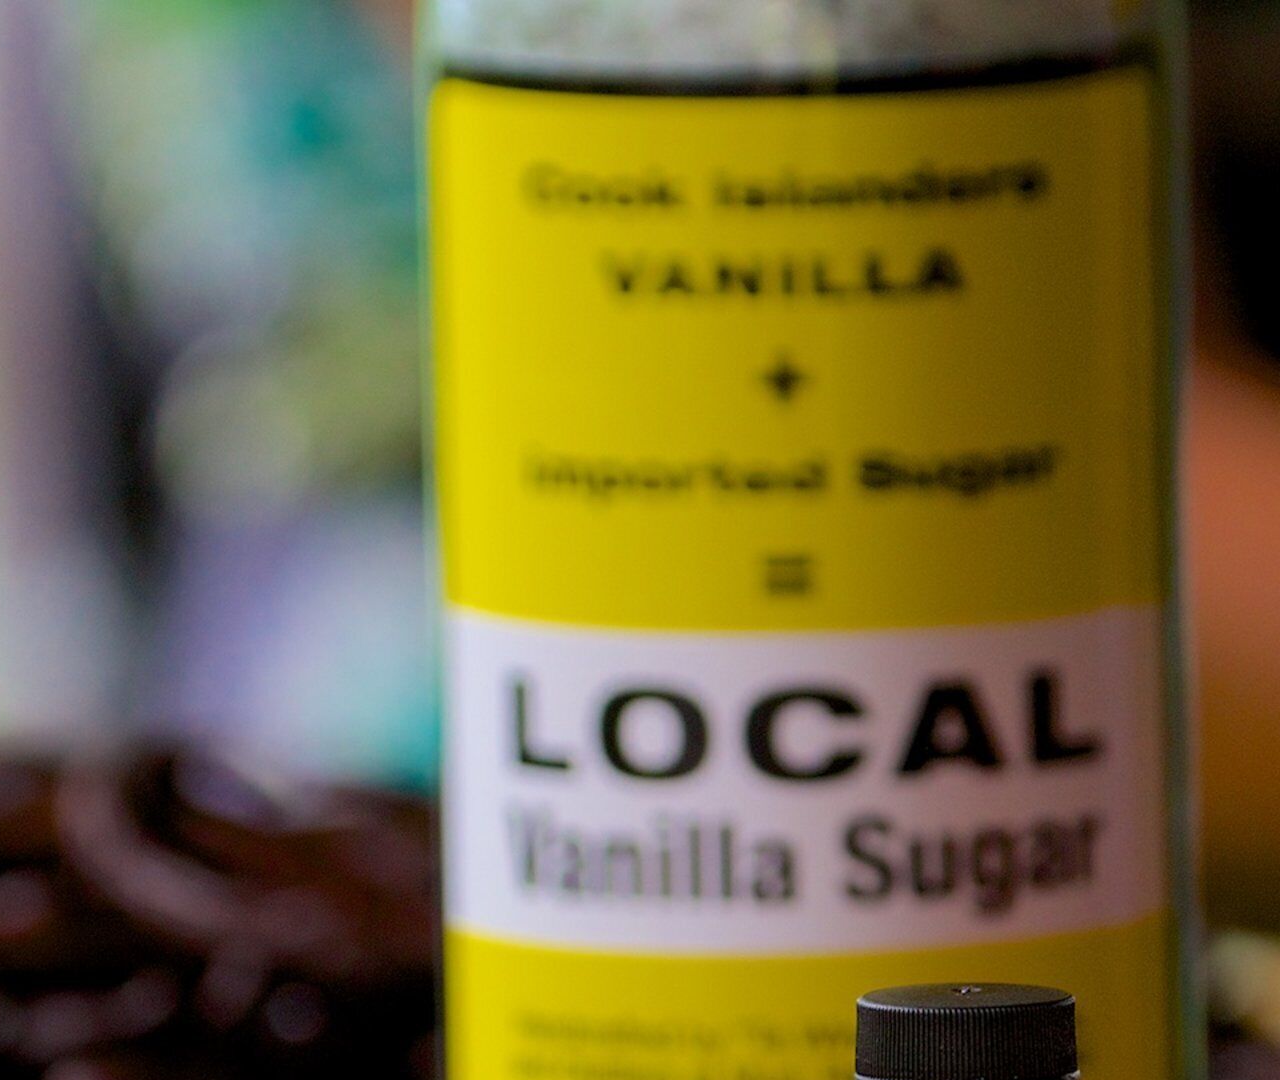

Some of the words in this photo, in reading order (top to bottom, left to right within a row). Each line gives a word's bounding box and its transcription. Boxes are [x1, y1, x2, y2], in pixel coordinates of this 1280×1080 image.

[526, 162, 681, 211] Cook
[604, 247, 966, 297] VANILLA
[858, 442, 1058, 500] Sugar
[510, 666, 1101, 784] LOCAL
[509, 808, 796, 904] Vanilla
[843, 812, 1101, 915] Sugar
